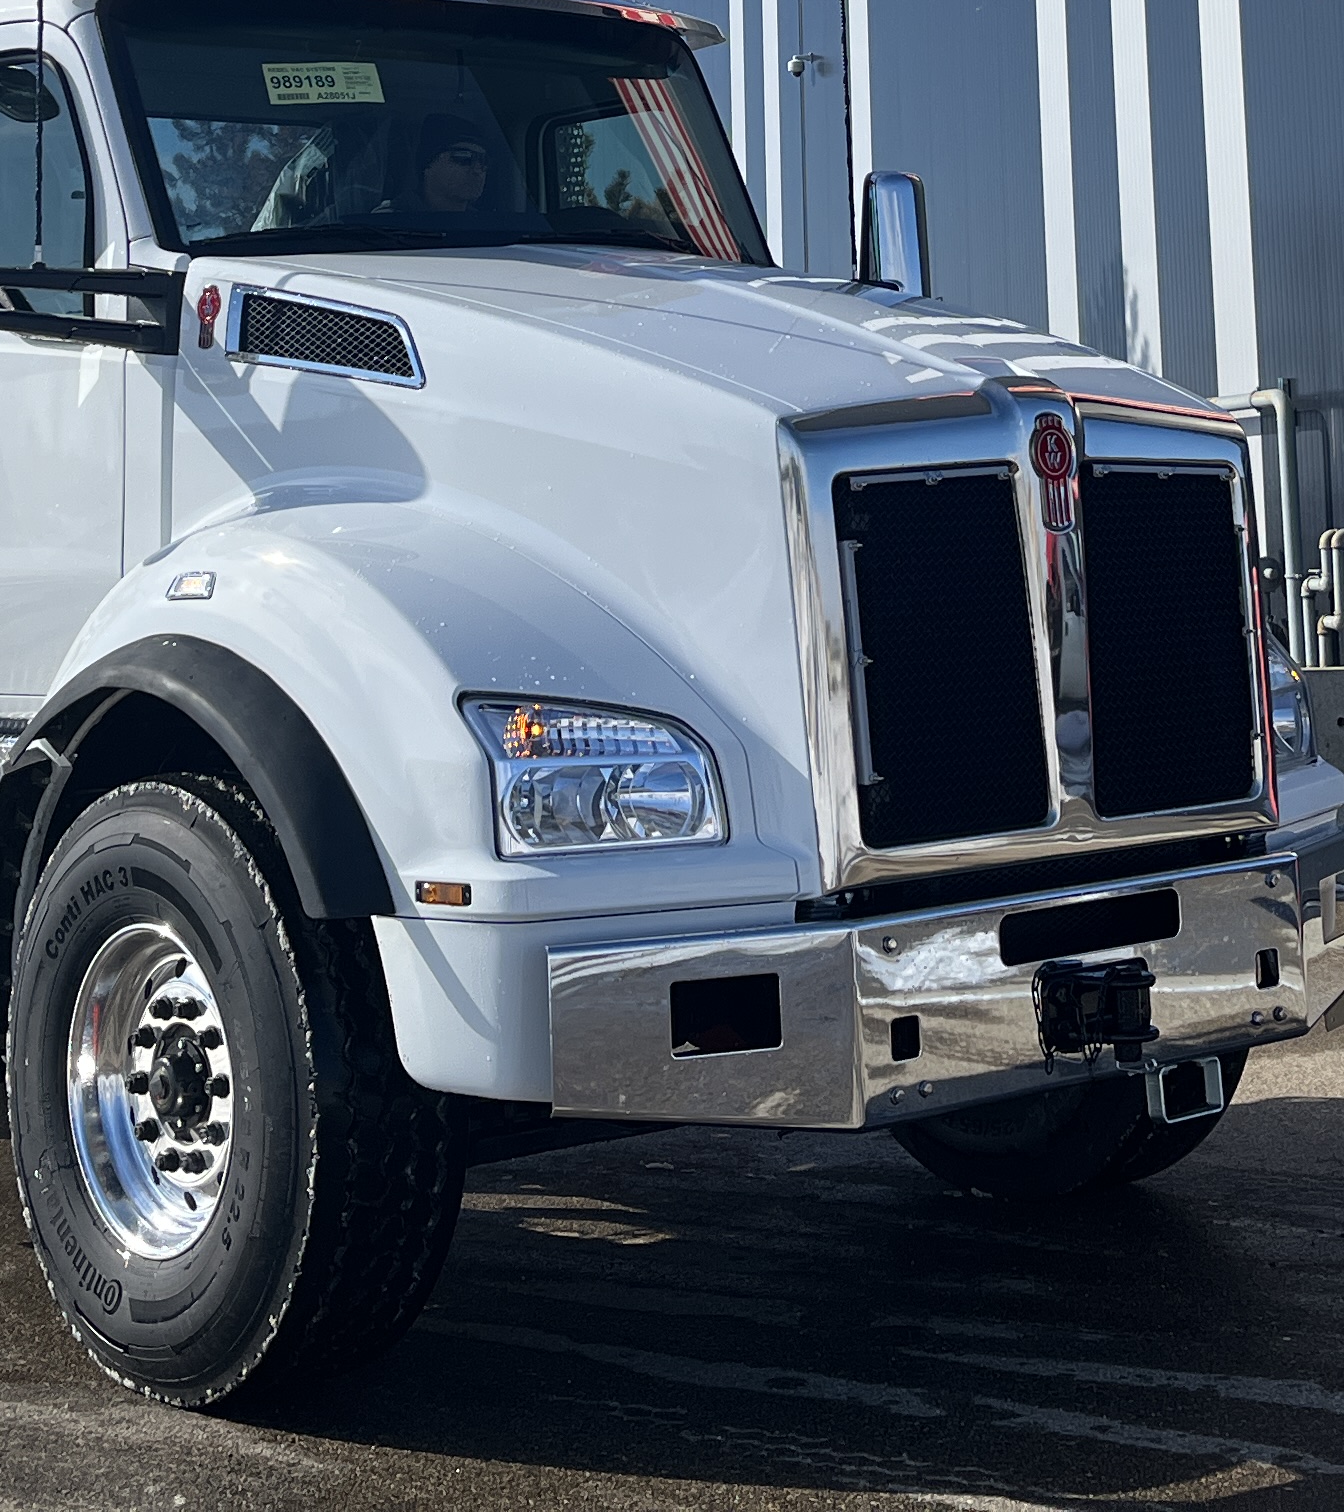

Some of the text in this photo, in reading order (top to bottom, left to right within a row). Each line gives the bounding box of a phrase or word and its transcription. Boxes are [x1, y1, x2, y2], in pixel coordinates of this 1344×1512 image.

[269, 74, 336, 89] 989189
[45, 865, 130, 960] Conti HAC 3
